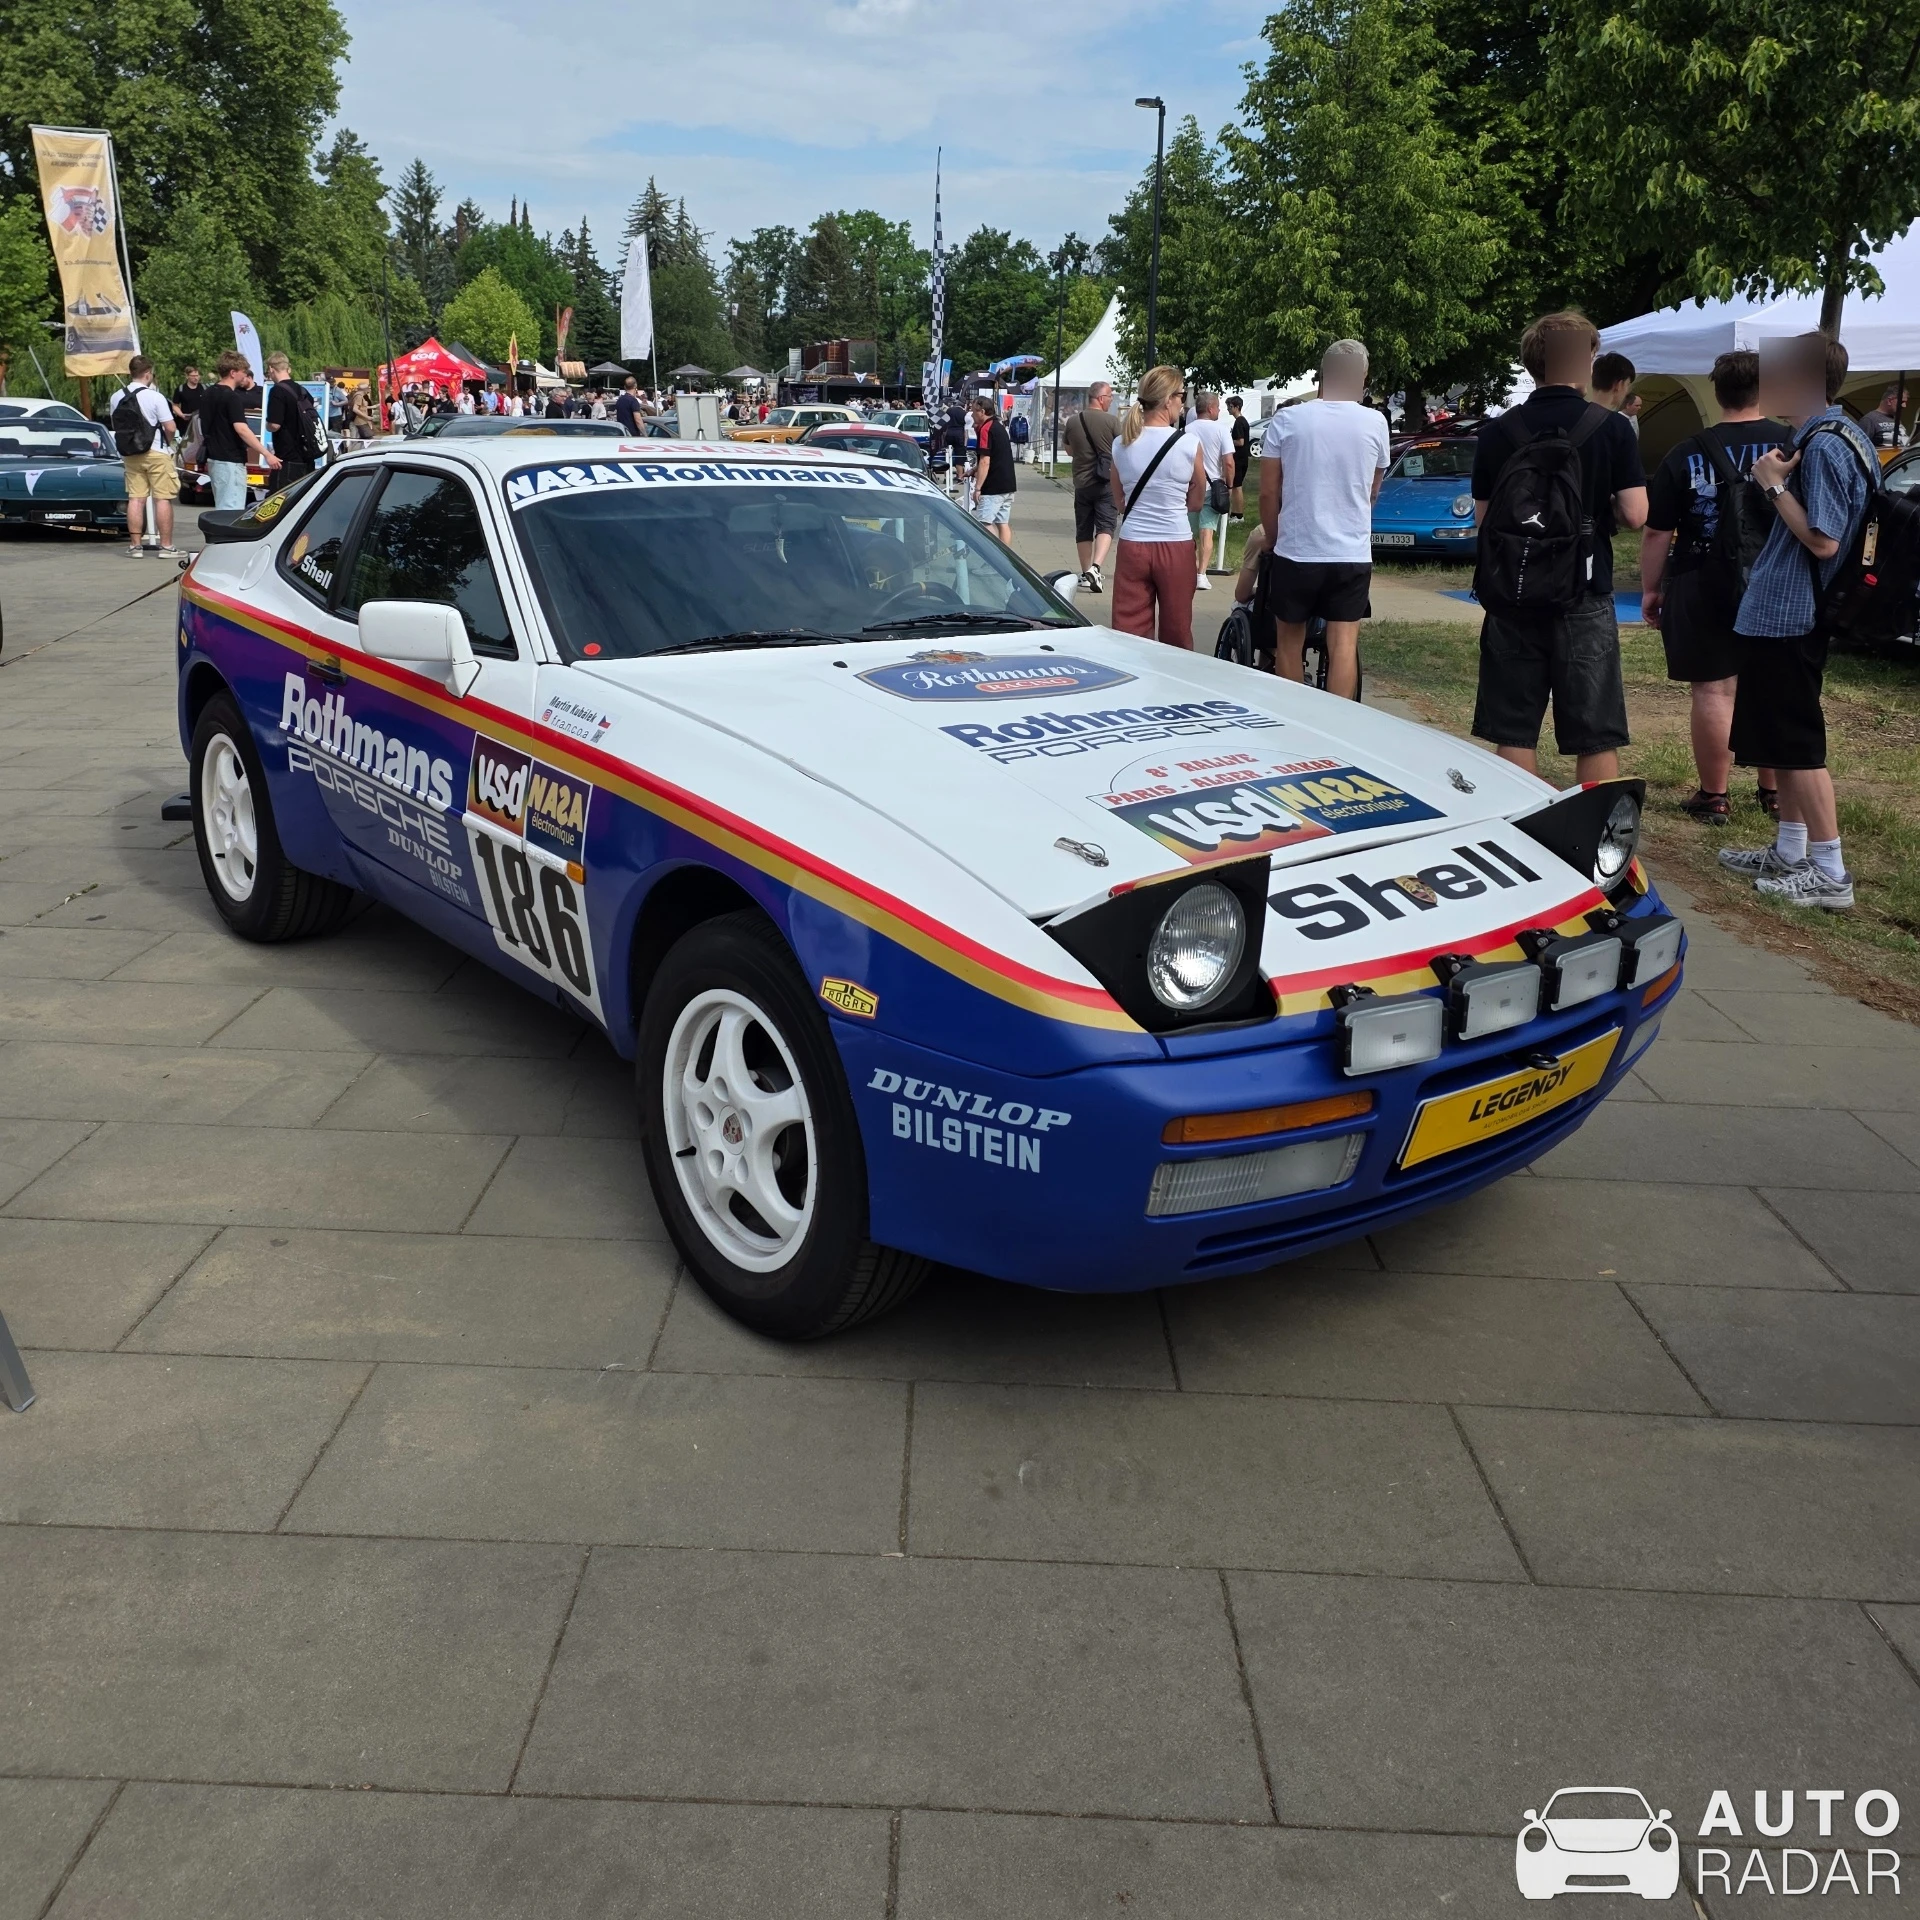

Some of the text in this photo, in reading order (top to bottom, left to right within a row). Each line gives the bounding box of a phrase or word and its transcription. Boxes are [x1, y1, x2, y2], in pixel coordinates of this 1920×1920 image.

[635, 463, 867, 485] Rothmans
[44, 512, 77, 520] LEGENDY
[1391, 534, 1411, 543] 1333
[300, 554, 334, 590] Shell
[901, 663, 1098, 690] Rothmans
[987, 677, 1068, 691] RACING
[548, 695, 598, 723] Martin Kubálek
[937, 698, 1250, 747] Rothmans
[279, 671, 454, 812] Rothmans
[986, 717, 1286, 765] PORSCHE
[1102, 784, 1178, 806] PARIS
[1190, 769, 1262, 789] ALGER
[1271, 758, 1344, 775] DAKAR
[1174, 753, 1260, 773] RALLYE
[287, 746, 453, 857] PORSCHE
[528, 773, 584, 833] NASA
[1264, 774, 1405, 811] NASA
[1318, 798, 1408, 820] électronique
[531, 812, 576, 847] électronique
[387, 827, 463, 880] DUNLOP
[429, 868, 471, 907] BILSTEIN
[1267, 840, 1543, 941] Shell
[475, 829, 592, 997] 186
[866, 1067, 1073, 1132] DUNLOP
[1468, 1061, 1576, 1123] LEGENDY
[892, 1102, 1041, 1174] BILSTEIN
